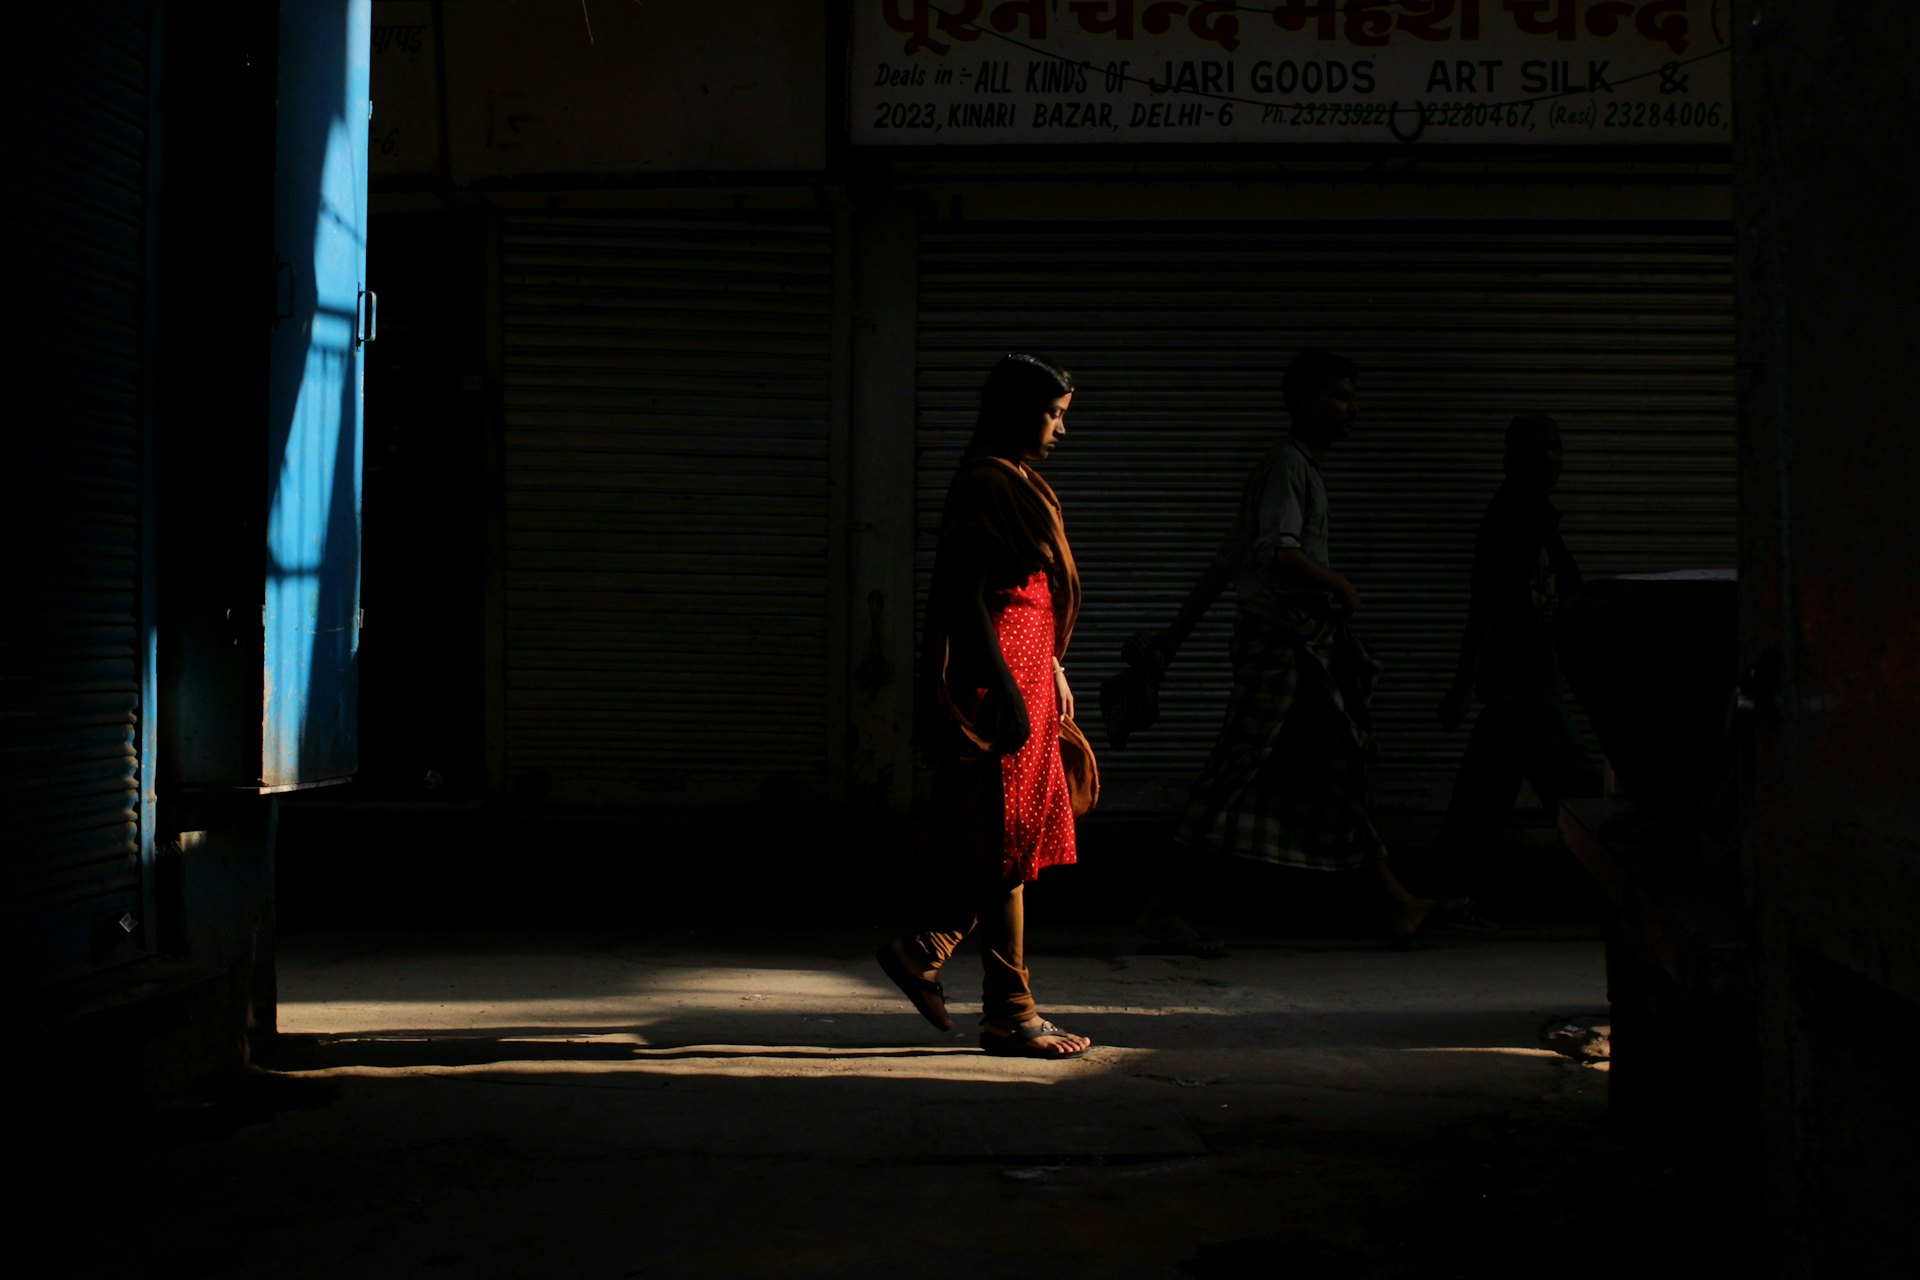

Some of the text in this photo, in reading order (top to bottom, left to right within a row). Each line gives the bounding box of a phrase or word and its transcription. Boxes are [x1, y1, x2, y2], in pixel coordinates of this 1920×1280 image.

[1272, 0, 1480, 46] महश
[874, 63, 926, 86] Deals
[935, 63, 953, 85] in
[974, 61, 1011, 93] ALL
[1026, 61, 1089, 93] KINDS
[1105, 61, 1130, 93] OF
[1149, 61, 1234, 94] JARI
[1251, 61, 1376, 93] GOODS
[1426, 60, 1502, 92] ART
[1521, 60, 1613, 93] SILK
[1660, 61, 1688, 94] &
[874, 102, 942, 132] 2023,
[948, 103, 1016, 128] KINARI
[1032, 103, 1119, 132] BAZAR,
[1128, 102, 1233, 127] DELHI-6
[1604, 102, 1728, 130] 23284006,
